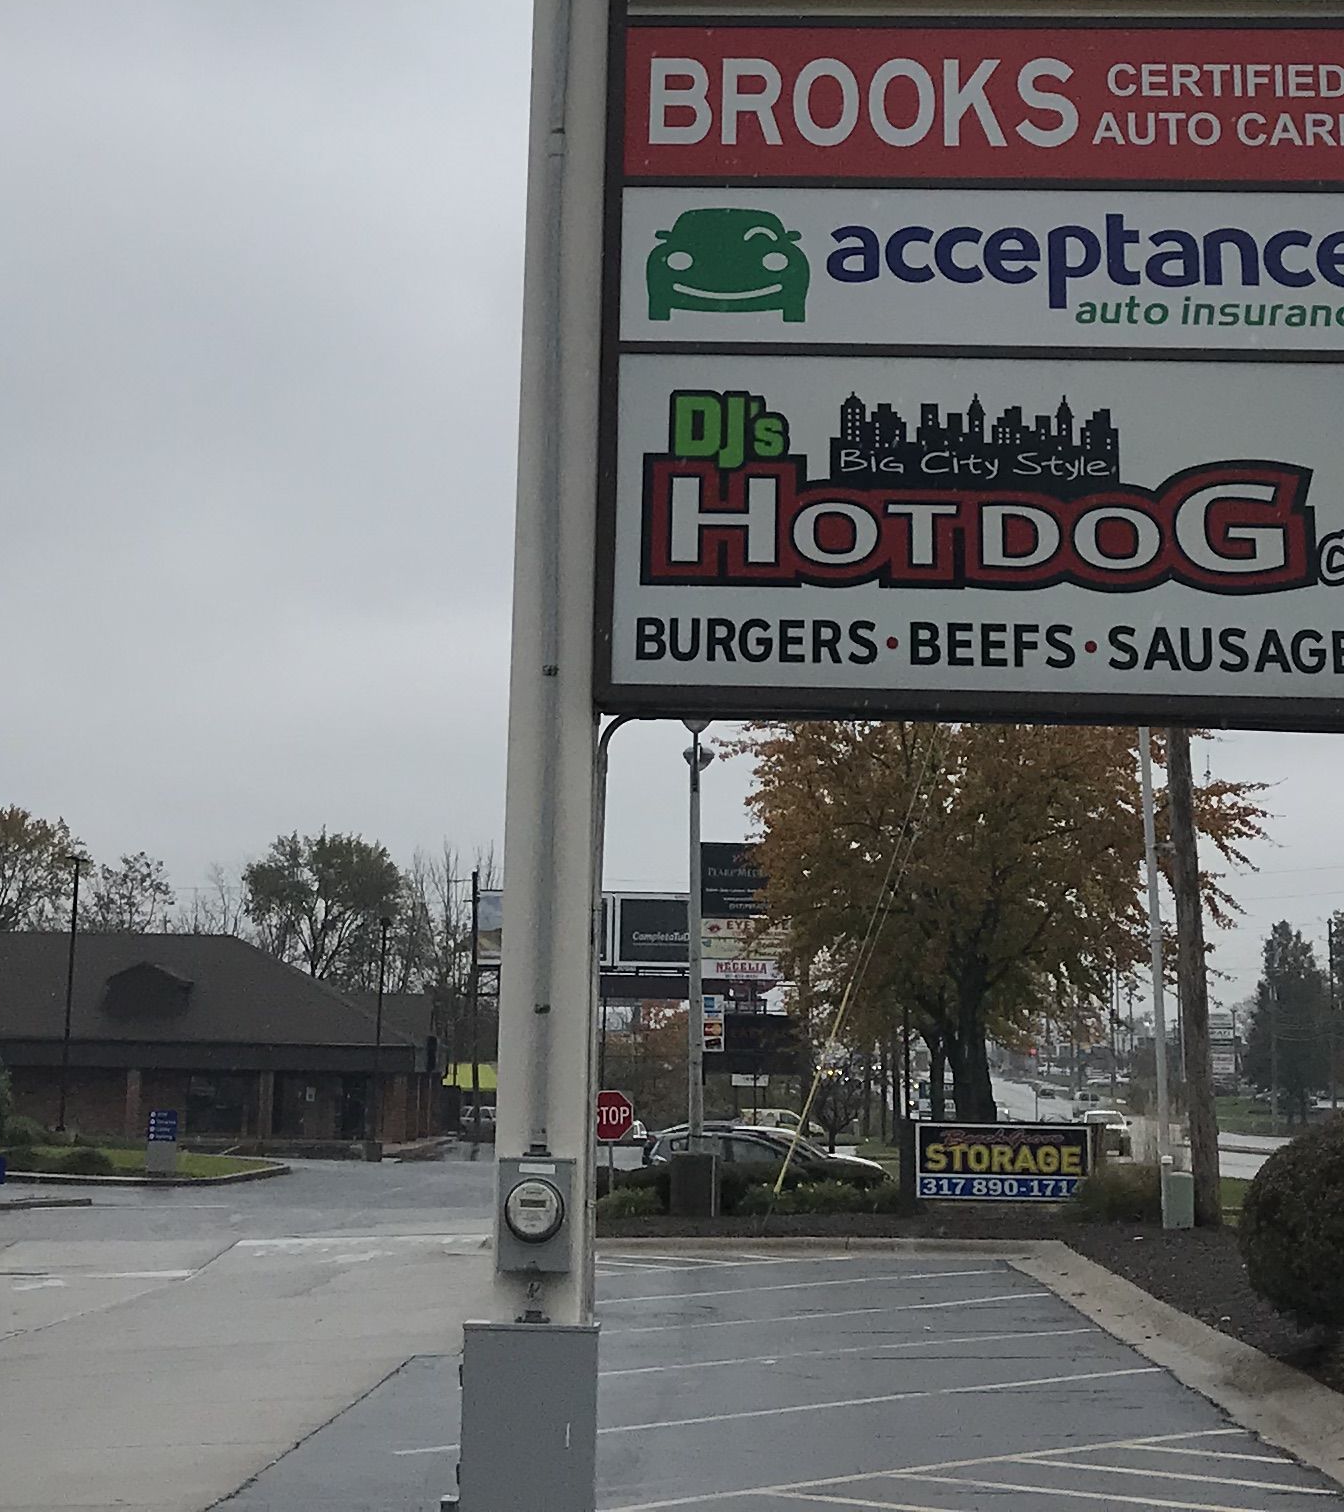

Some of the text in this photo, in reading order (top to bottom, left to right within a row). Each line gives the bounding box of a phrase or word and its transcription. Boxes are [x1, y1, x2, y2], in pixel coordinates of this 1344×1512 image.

[646, 57, 1080, 149] BROOKS
[1092, 112, 1222, 147] AUTO
[1074, 296, 1170, 327] auto
[673, 394, 786, 469] DJ's
[920, 449, 1000, 480] City
[635, 617, 880, 666] BURGERS
[909, 621, 1076, 671] BEEFS
[925, 1143, 1083, 1176] STORAGE
[922, 1179, 966, 1195] 317
